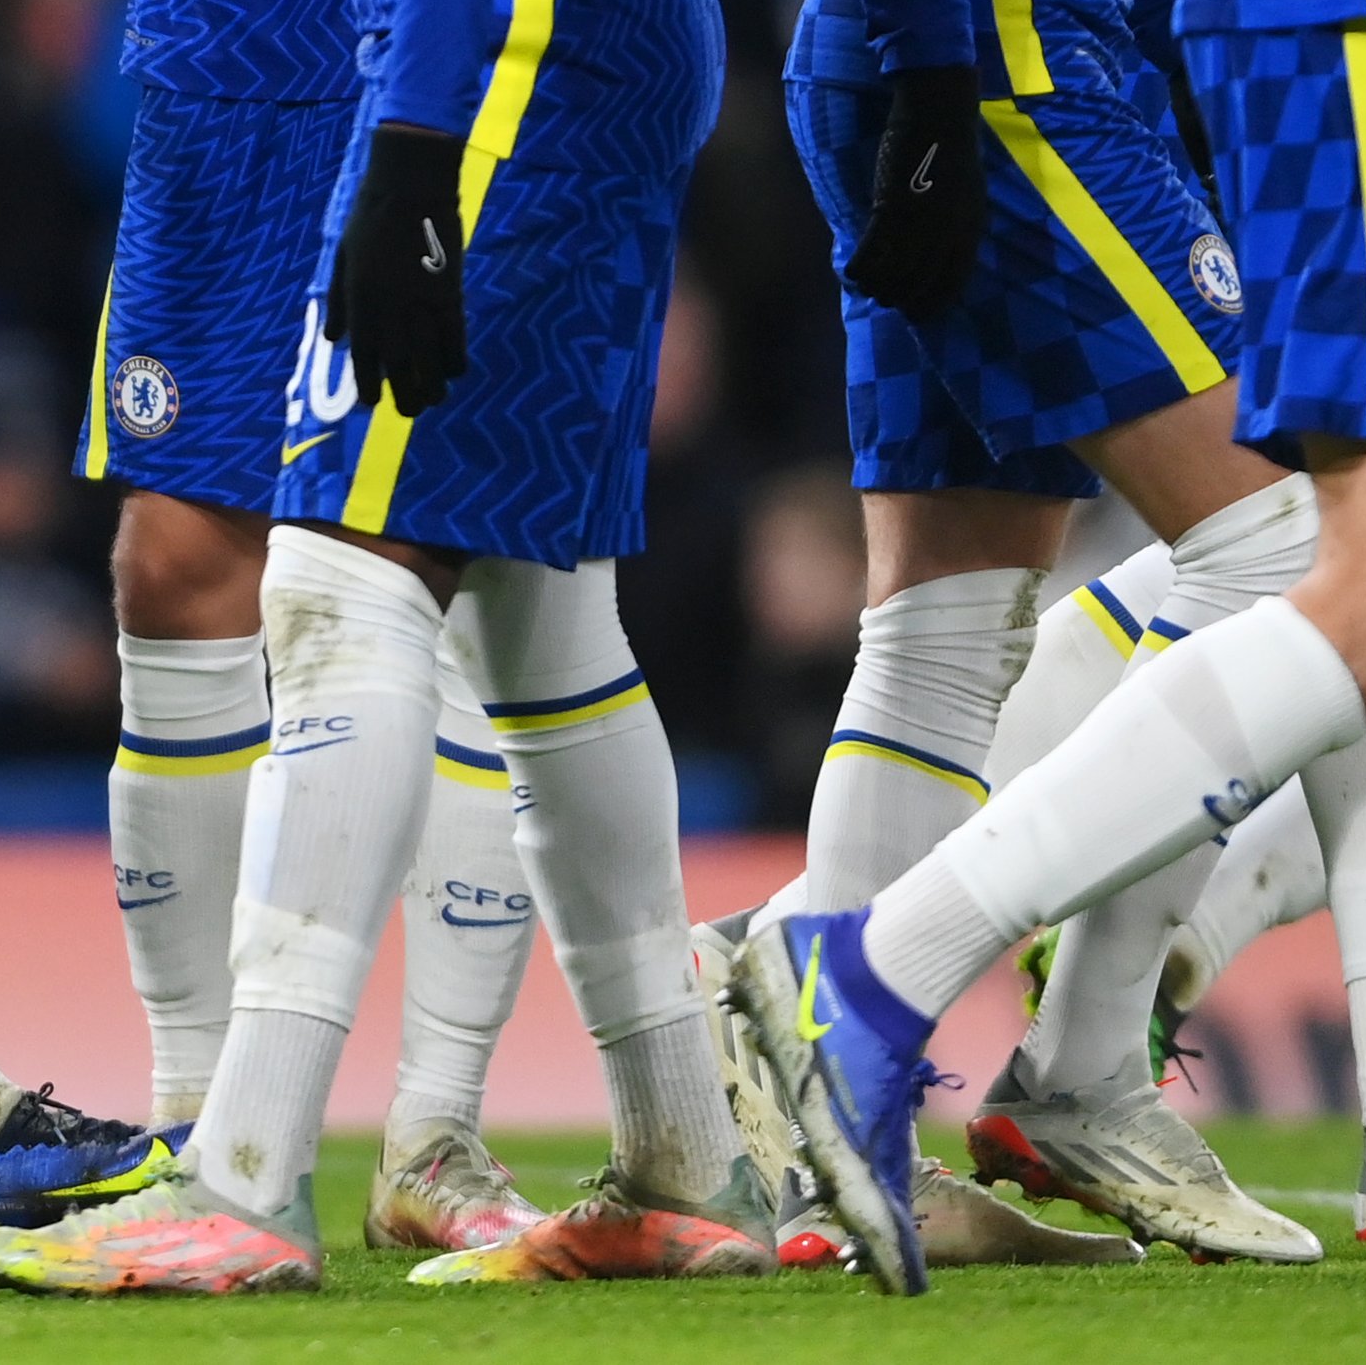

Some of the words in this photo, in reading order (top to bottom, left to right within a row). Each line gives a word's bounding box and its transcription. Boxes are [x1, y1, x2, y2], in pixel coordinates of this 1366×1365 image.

[122, 359, 165, 379] CHELSEA
[278, 716, 353, 737] CFC
[445, 880, 531, 911] CFC
